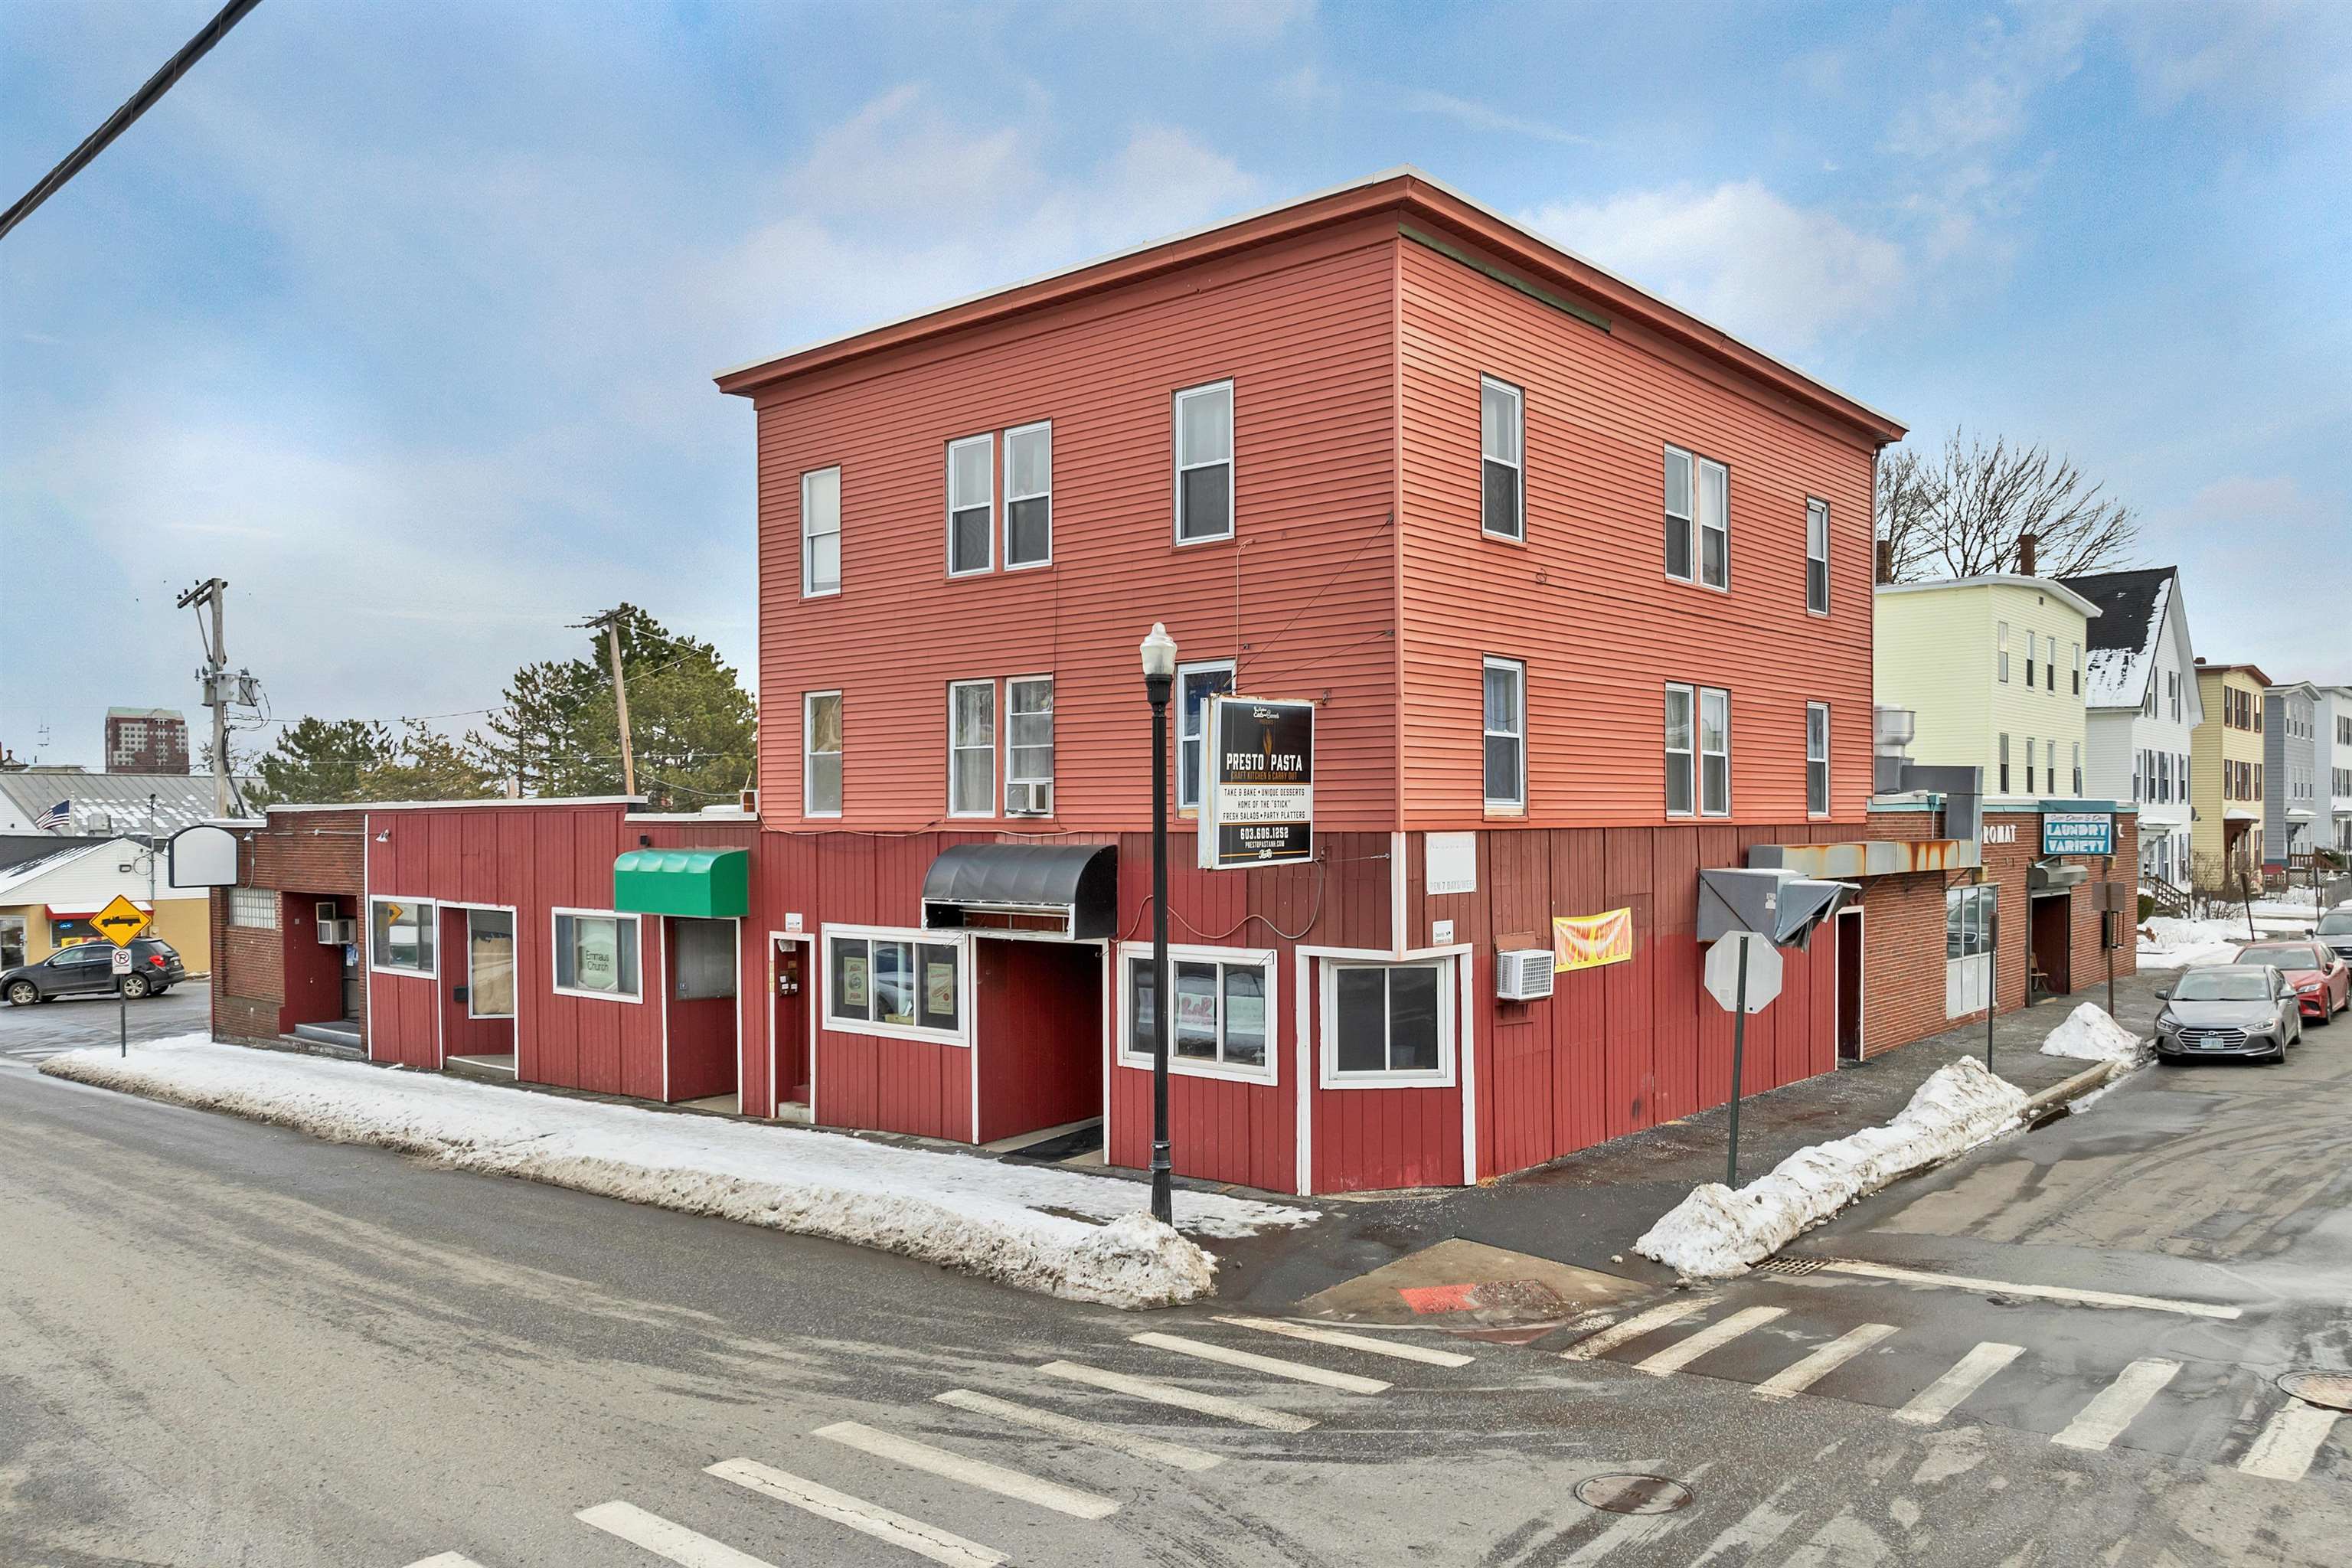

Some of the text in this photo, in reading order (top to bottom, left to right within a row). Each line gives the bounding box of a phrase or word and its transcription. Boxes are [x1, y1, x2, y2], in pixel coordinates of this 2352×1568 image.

[1227, 753, 1302, 771] PRESTO PASTA
[1231, 771, 1246, 780] CRAFT
[1247, 771, 1266, 780] KITCHEN
[1272, 772, 1287, 780] CARRY
[1288, 772, 1297, 780] OUT
[1237, 800, 1251, 808] HOME
[1271, 799, 1291, 808] "STICK"
[1223, 812, 1239, 821] FRESH
[1240, 812, 1259, 820] SALADS
[1280, 811, 1305, 819] PLATTERS
[1240, 827, 1289, 840] 603.606.1252
[1981, 825, 2017, 844] ROMAT
[2046, 824, 2108, 836] LAUNDRY
[2047, 840, 2106, 852] VARIETY
[1555, 913, 1629, 965] NOW OPEN
[586, 949, 609, 962] Emmaus
[587, 961, 609, 972] Church
